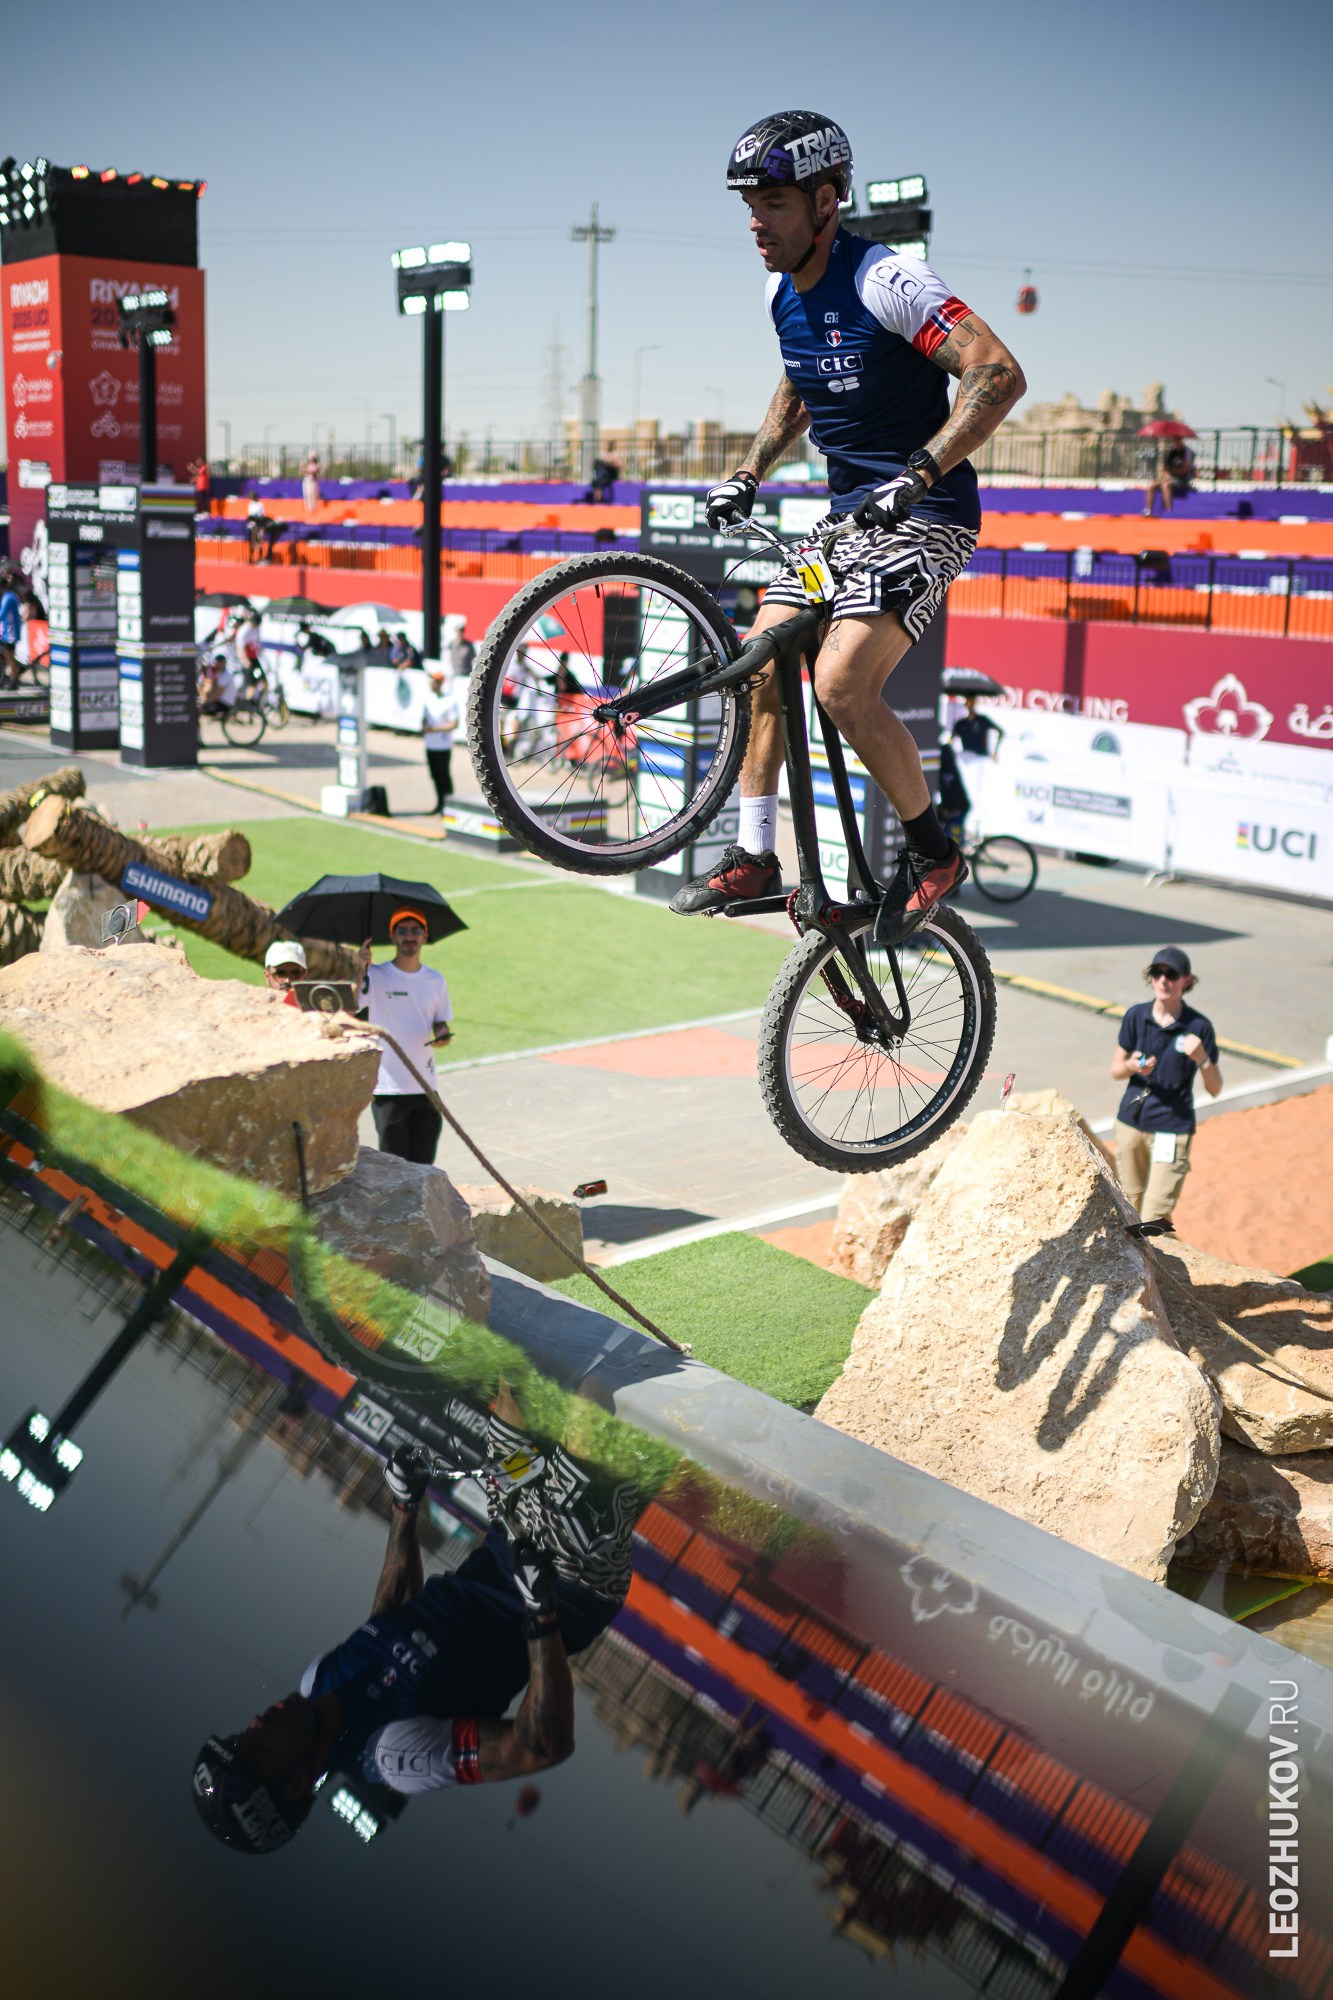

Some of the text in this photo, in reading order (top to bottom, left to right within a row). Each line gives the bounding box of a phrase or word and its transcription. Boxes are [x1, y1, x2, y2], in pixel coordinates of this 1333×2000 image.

[784, 126, 845, 161] TRIAL
[793, 143, 851, 181] BIKES
[876, 265, 917, 296] CIC
[820, 355, 857, 371] CIC
[658, 502, 691, 521] UCI
[1026, 689, 1129, 723] CYCLING
[1022, 784, 1050, 801] UCI
[1252, 825, 1317, 860] UCI
[820, 849, 849, 872] UC
[126, 869, 208, 914] SHIMANO
